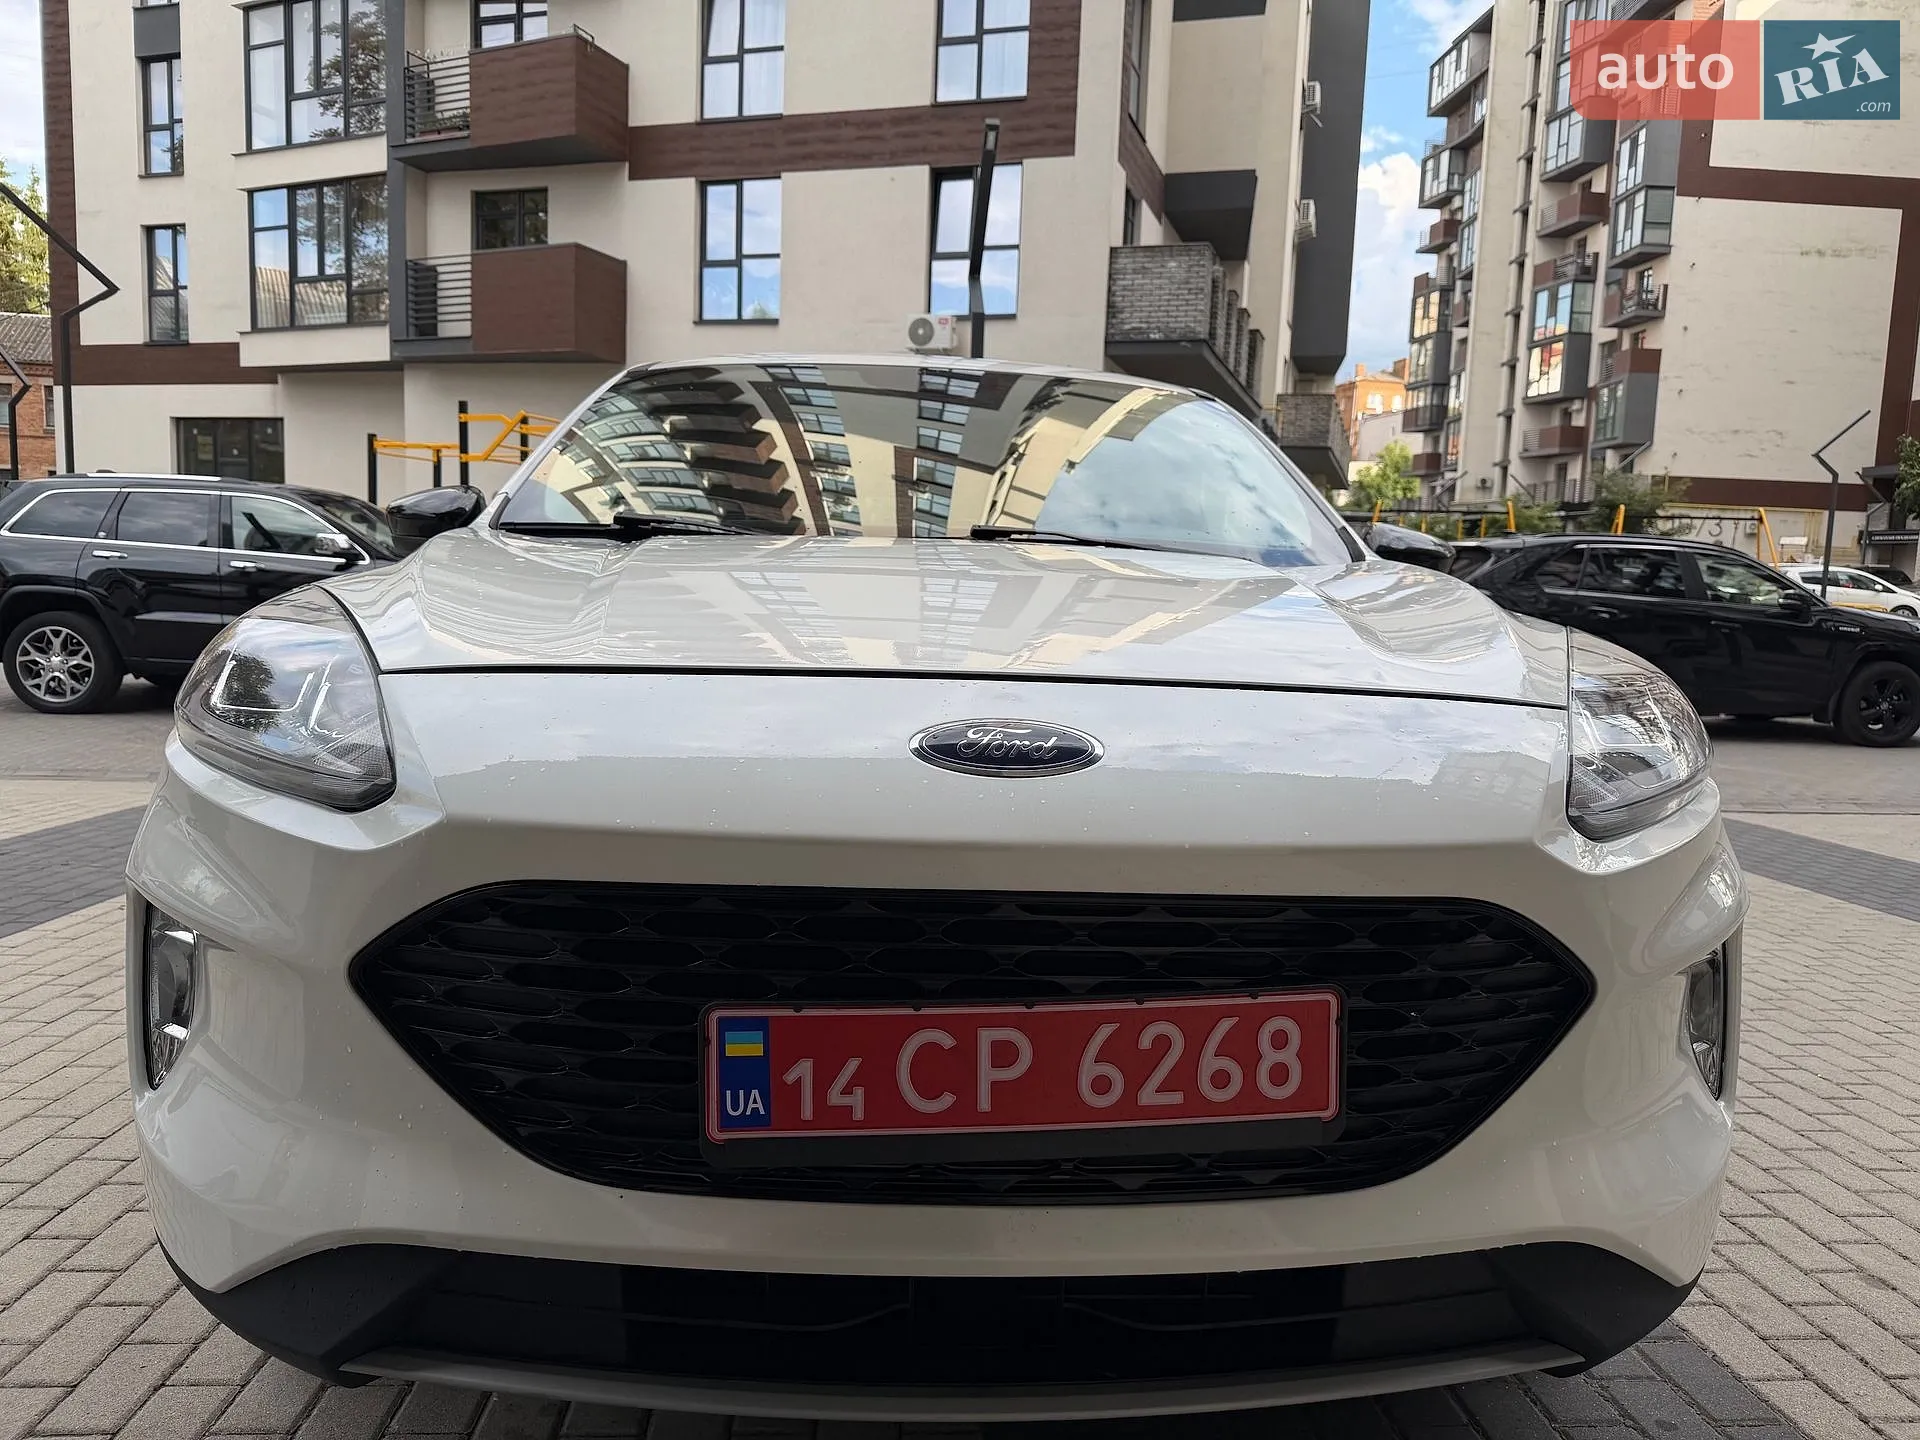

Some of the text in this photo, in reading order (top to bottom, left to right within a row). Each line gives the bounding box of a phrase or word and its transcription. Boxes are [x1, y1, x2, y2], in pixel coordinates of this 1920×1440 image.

[957, 726, 1058, 759] Ford
[783, 1016, 1302, 1120] 14 CP 6268
[726, 1089, 765, 1116] UA
